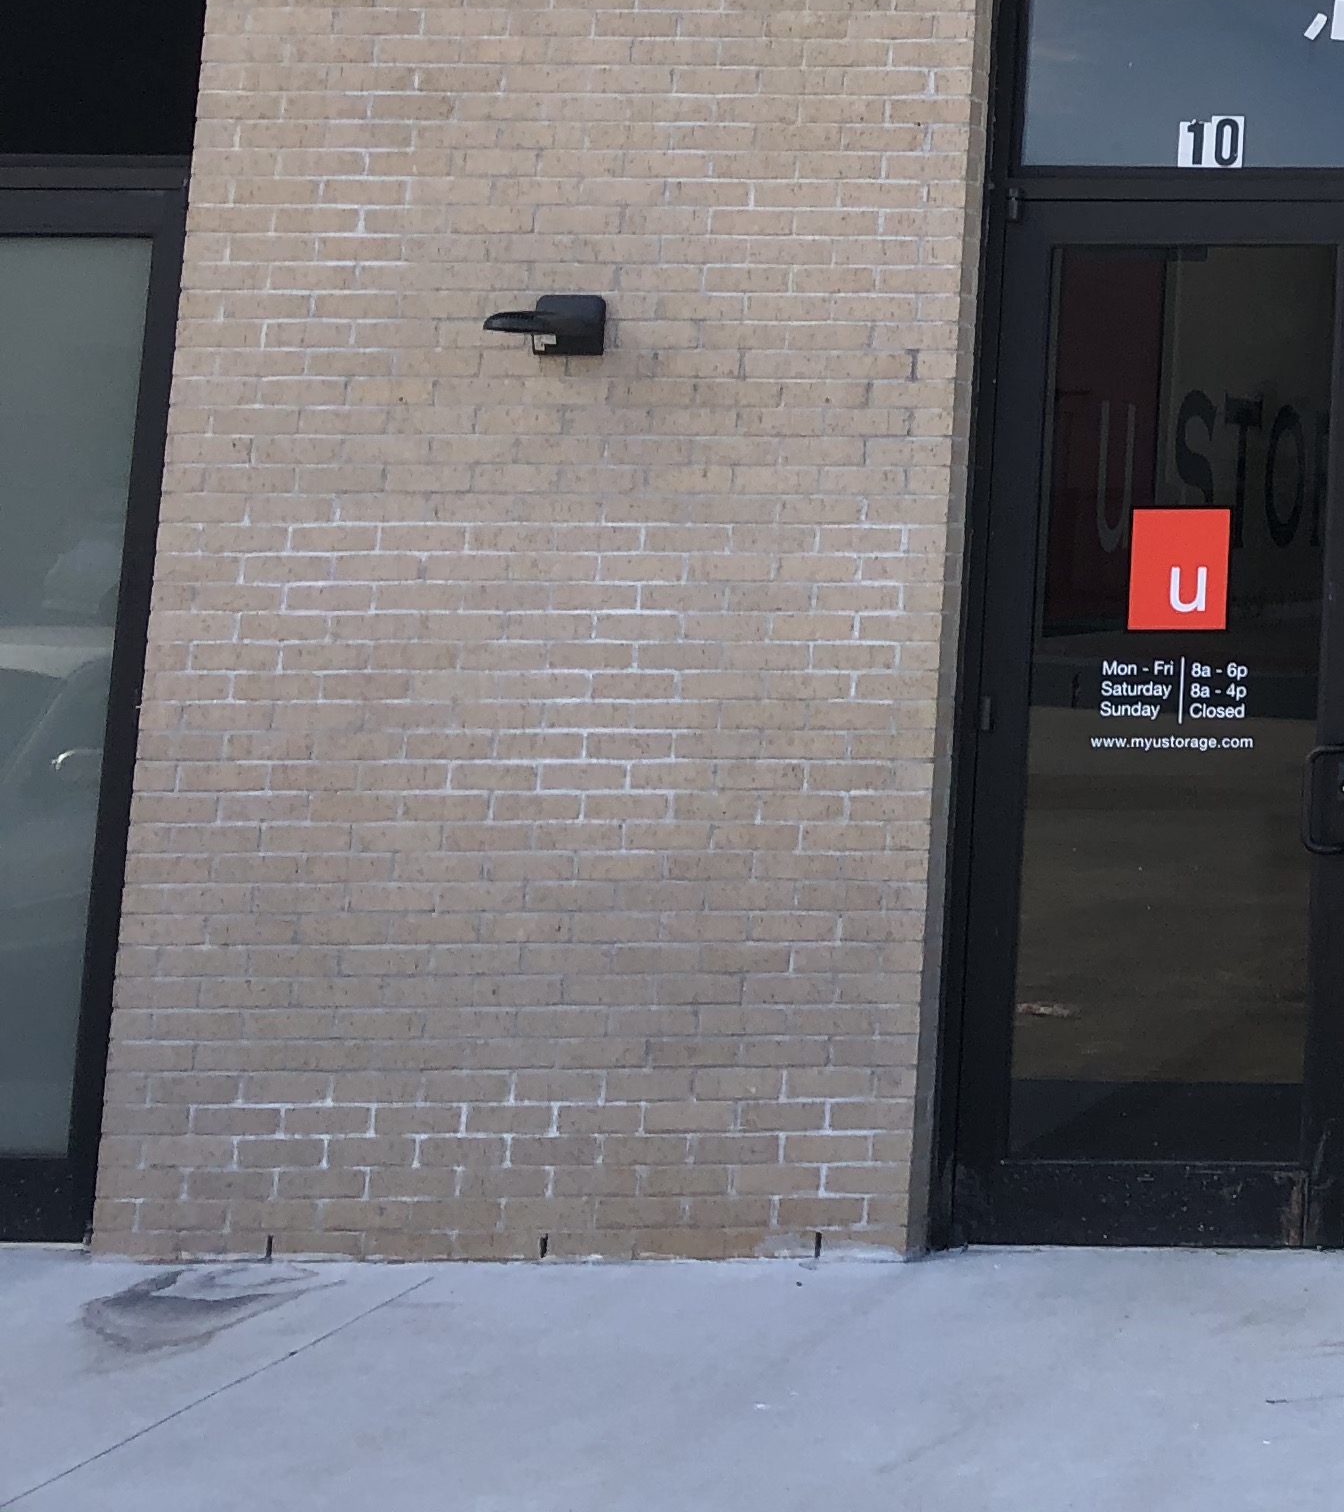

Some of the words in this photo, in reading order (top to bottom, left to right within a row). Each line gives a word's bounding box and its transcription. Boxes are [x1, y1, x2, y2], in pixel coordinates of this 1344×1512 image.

[1187, 118, 1239, 166] 10
[1169, 566, 1207, 613] u
[1102, 660, 1138, 676] Mon
[1153, 660, 1174, 676] Fri
[1191, 662, 1211, 678] 8a
[1226, 662, 1248, 681] 6p
[1101, 680, 1172, 700] Saturday
[1190, 682, 1211, 698] 8a
[1225, 683, 1247, 701] 4p
[1100, 700, 1161, 721] Sunday
[1189, 702, 1246, 719] Closed
[1090, 735, 1254, 752] www.myustorage.com
